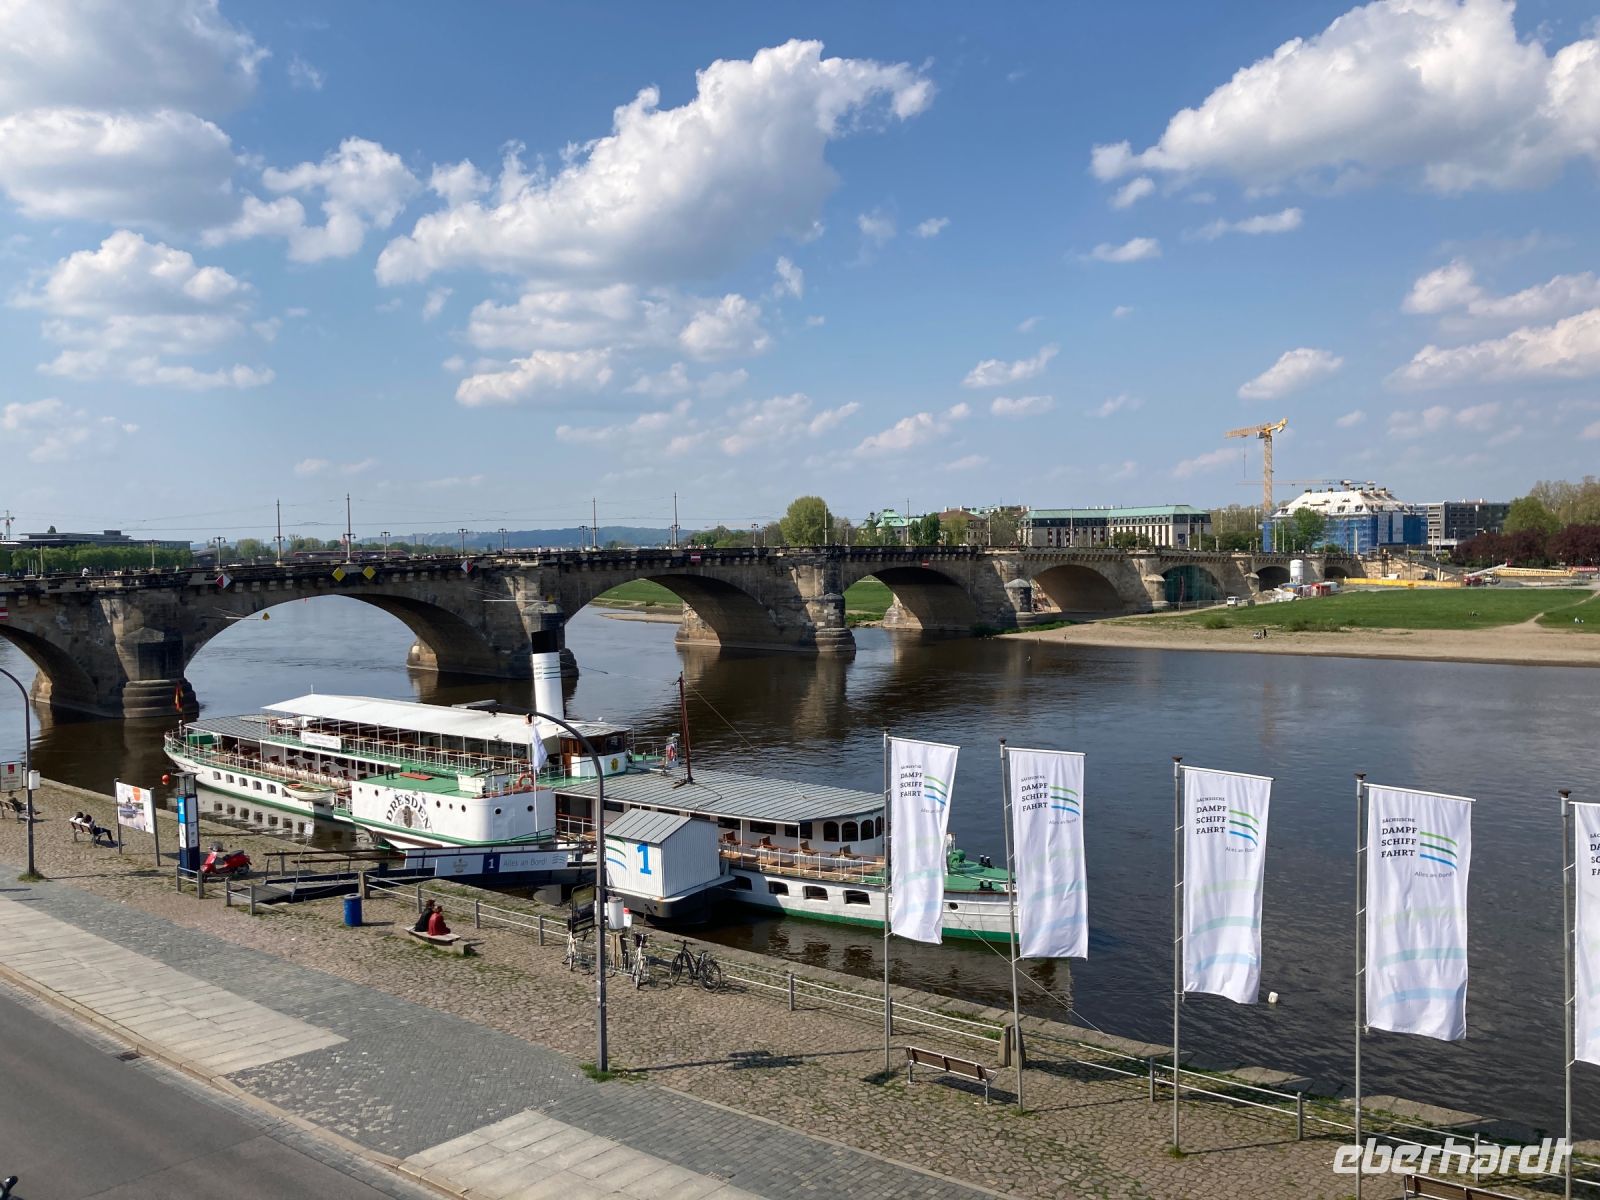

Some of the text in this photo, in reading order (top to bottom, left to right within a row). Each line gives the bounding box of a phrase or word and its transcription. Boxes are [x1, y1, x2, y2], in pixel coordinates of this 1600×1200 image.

[900, 771, 923, 779] DAMPF
[1021, 782, 1048, 792] DAMPF
[1021, 792, 1048, 802] SCHIFF
[1022, 802, 1048, 812] FAHRT
[1196, 804, 1227, 813] DAMPF
[386, 794, 432, 832] DRESDEN
[1196, 815, 1227, 824] SCHIFF
[1196, 826, 1226, 835] FAHRT
[1382, 826, 1418, 835] DAMPF
[1381, 837, 1417, 847] SCHIFF
[636, 842, 652, 875] 1
[1381, 849, 1416, 858] FAHRT
[487, 858, 495, 869] 1
